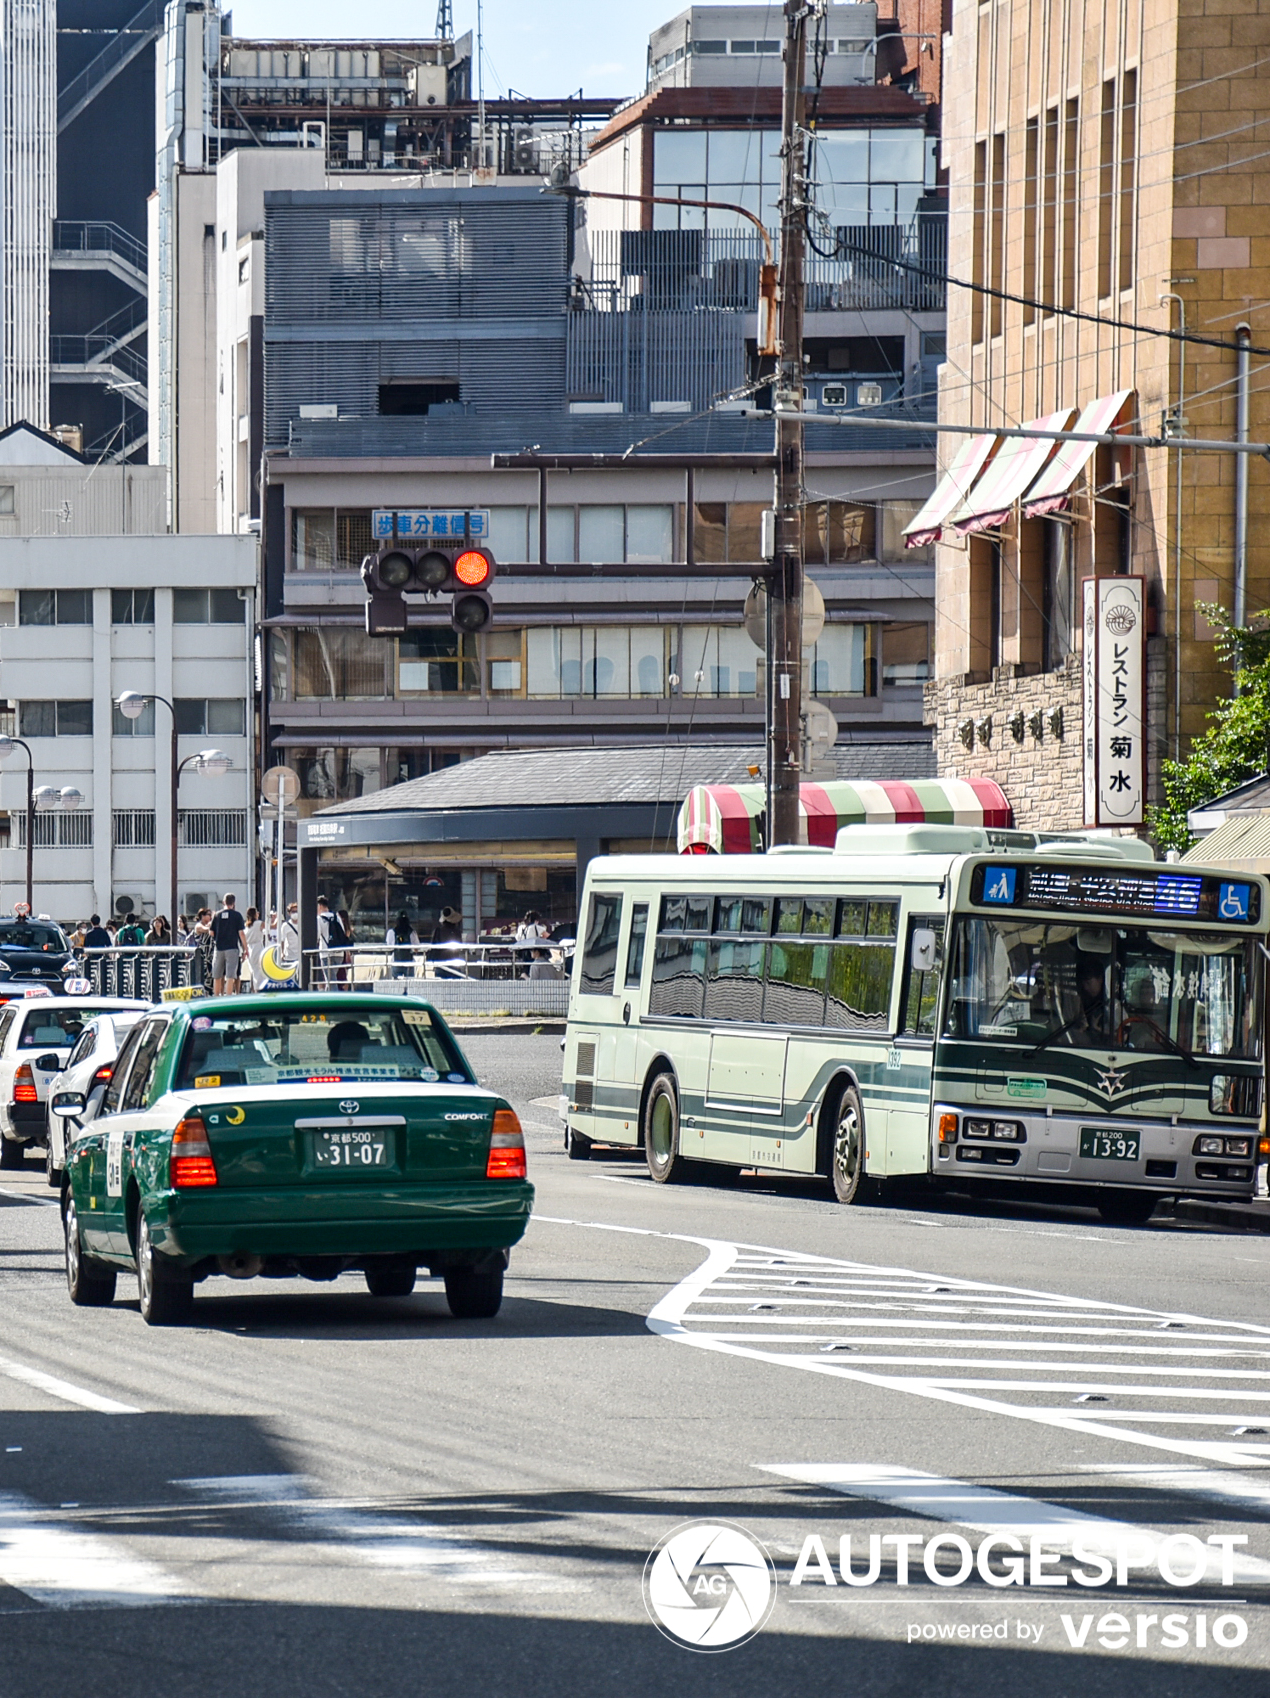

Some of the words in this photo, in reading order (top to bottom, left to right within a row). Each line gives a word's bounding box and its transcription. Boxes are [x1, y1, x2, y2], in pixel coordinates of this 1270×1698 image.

[378, 514, 485, 535] 歩車分離信号
[444, 1112, 489, 1121] COMFORT
[329, 1144, 384, 1166] 31-07
[1092, 1138, 1137, 1159] 13-92
